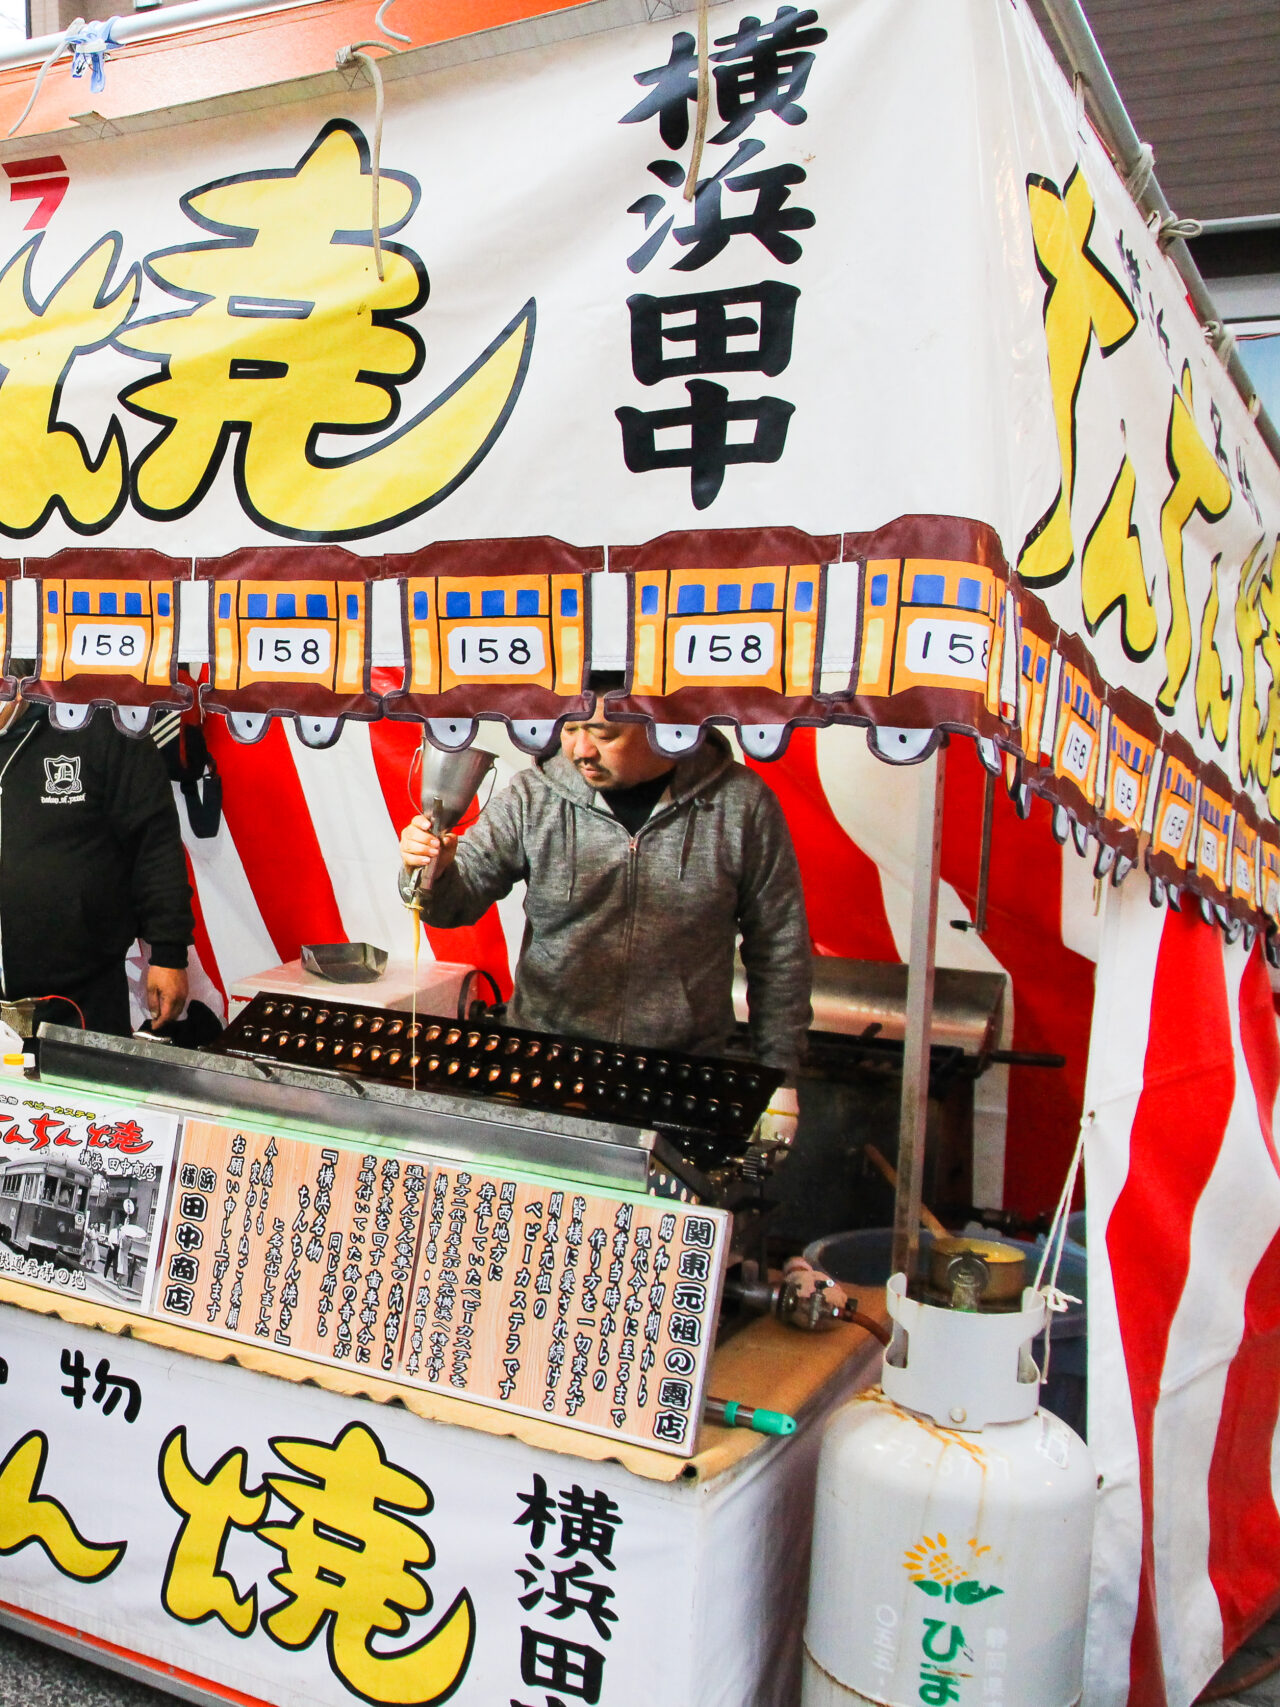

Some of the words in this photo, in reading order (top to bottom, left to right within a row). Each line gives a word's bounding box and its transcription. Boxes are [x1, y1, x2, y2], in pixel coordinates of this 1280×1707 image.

[614, 5, 829, 511] 横浜田中
[81, 633, 135, 658] 158
[257, 636, 321, 666] 158
[460, 636, 532, 667] 158
[686, 633, 764, 666] 158
[22, 1100, 97, 1120] ベビーカステラ
[78, 1149, 104, 1171] 横浜
[108, 1157, 157, 1183] 田中商店
[180, 1163, 217, 1193] 横浜
[255, 1136, 278, 1236] 今後とも
[163, 1192, 207, 1316] 田中商店
[206, 1133, 246, 1322] お願い申し上げます
[316, 1231, 343, 1338] 同じ所から
[333, 1154, 377, 1359] 当時付いていた鈴の音色が
[449, 1181, 496, 1388] 存在していたベビーカステラを
[488, 1181, 517, 1282] 関西地方に
[499, 1201, 543, 1400] ベビーカステラです
[533, 1191, 564, 1319] 関東元祖の
[542, 1196, 586, 1412] 皆様に愛され続ける
[592, 1202, 633, 1392] 創業当時からの
[566, 1228, 607, 1416] 作り方を一切変えず
[611, 1226, 652, 1428] 現代令和に至るまで
[637, 1213, 677, 1408] 昭和初期から
[653, 1215, 715, 1444] 関東元祖の露店
[510, 1472, 624, 1707] 横浜田
